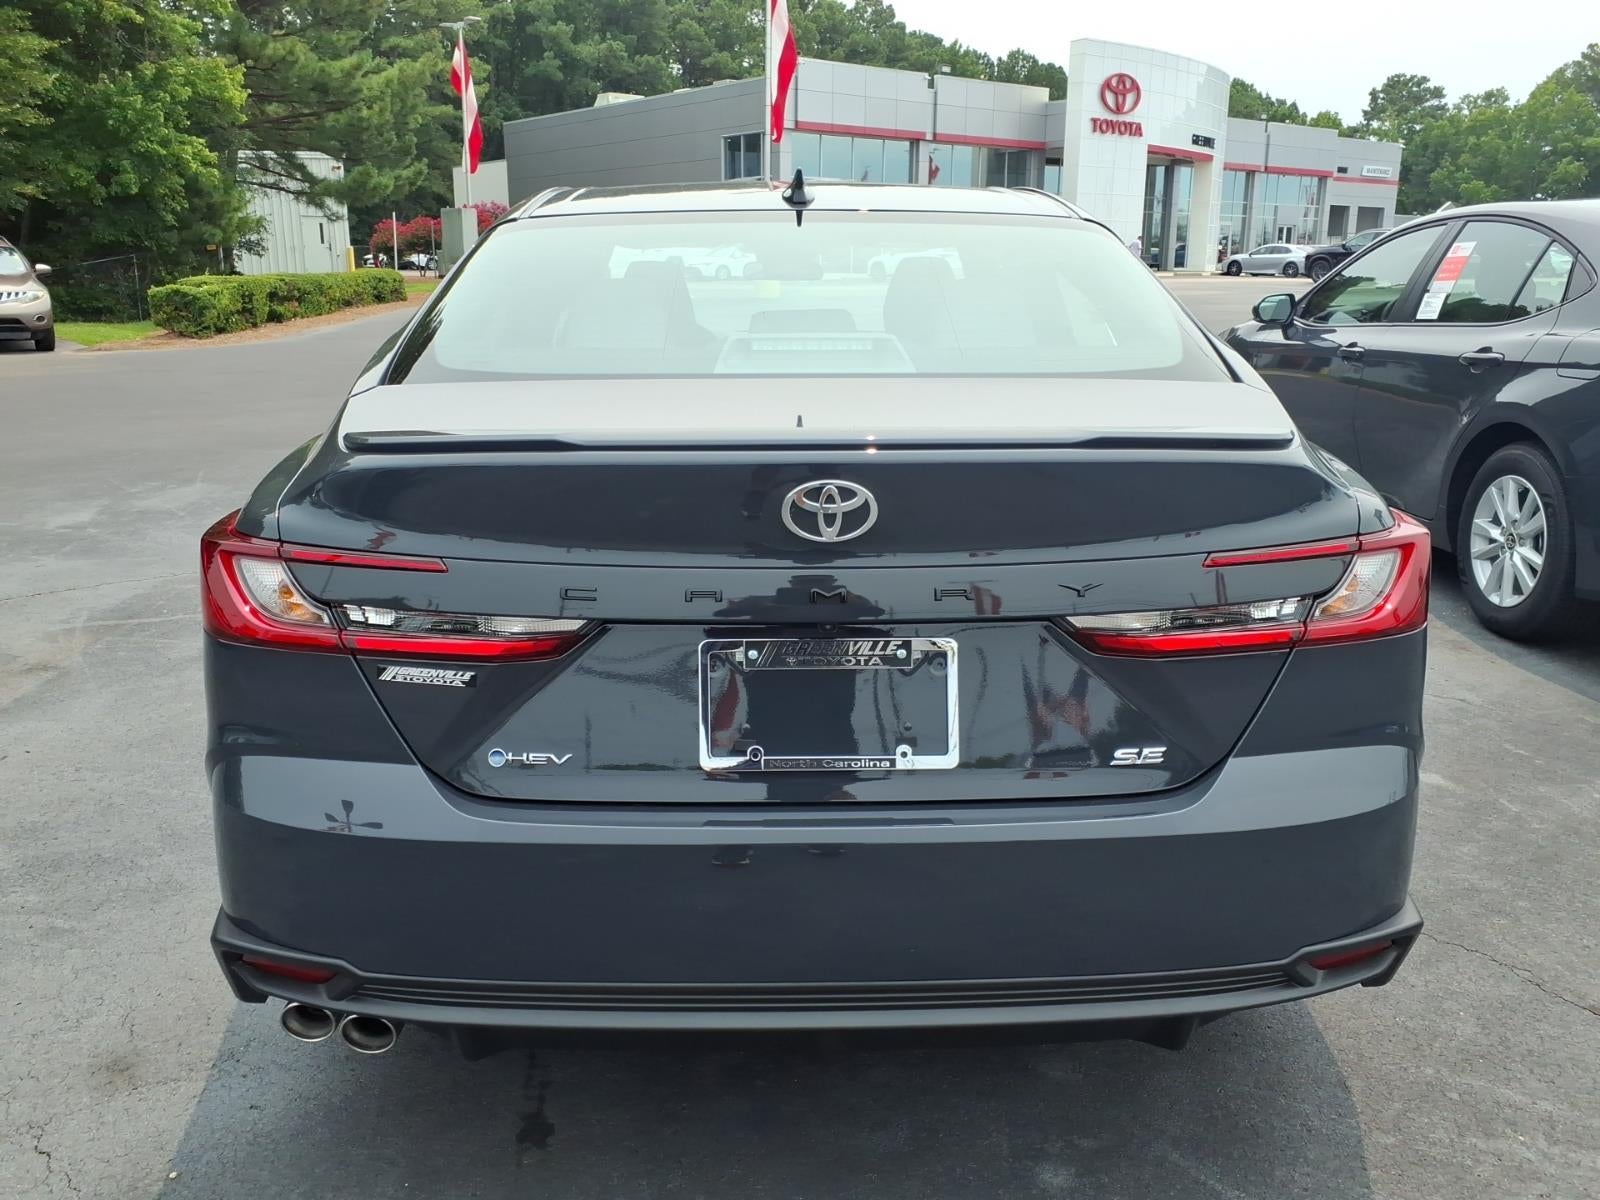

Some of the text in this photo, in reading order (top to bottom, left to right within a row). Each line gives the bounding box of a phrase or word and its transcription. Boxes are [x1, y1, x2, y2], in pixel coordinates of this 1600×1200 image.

[1091, 117, 1143, 137] TOYOTA
[560, 583, 1103, 603] CAMRY
[798, 656, 883, 666] TOYOTA
[398, 666, 476, 680] GREENVILLE
[404, 675, 463, 686] TOYOTA
[506, 752, 572, 764] HEV
[1109, 746, 1167, 766] SE
[823, 759, 891, 769] Carolina
